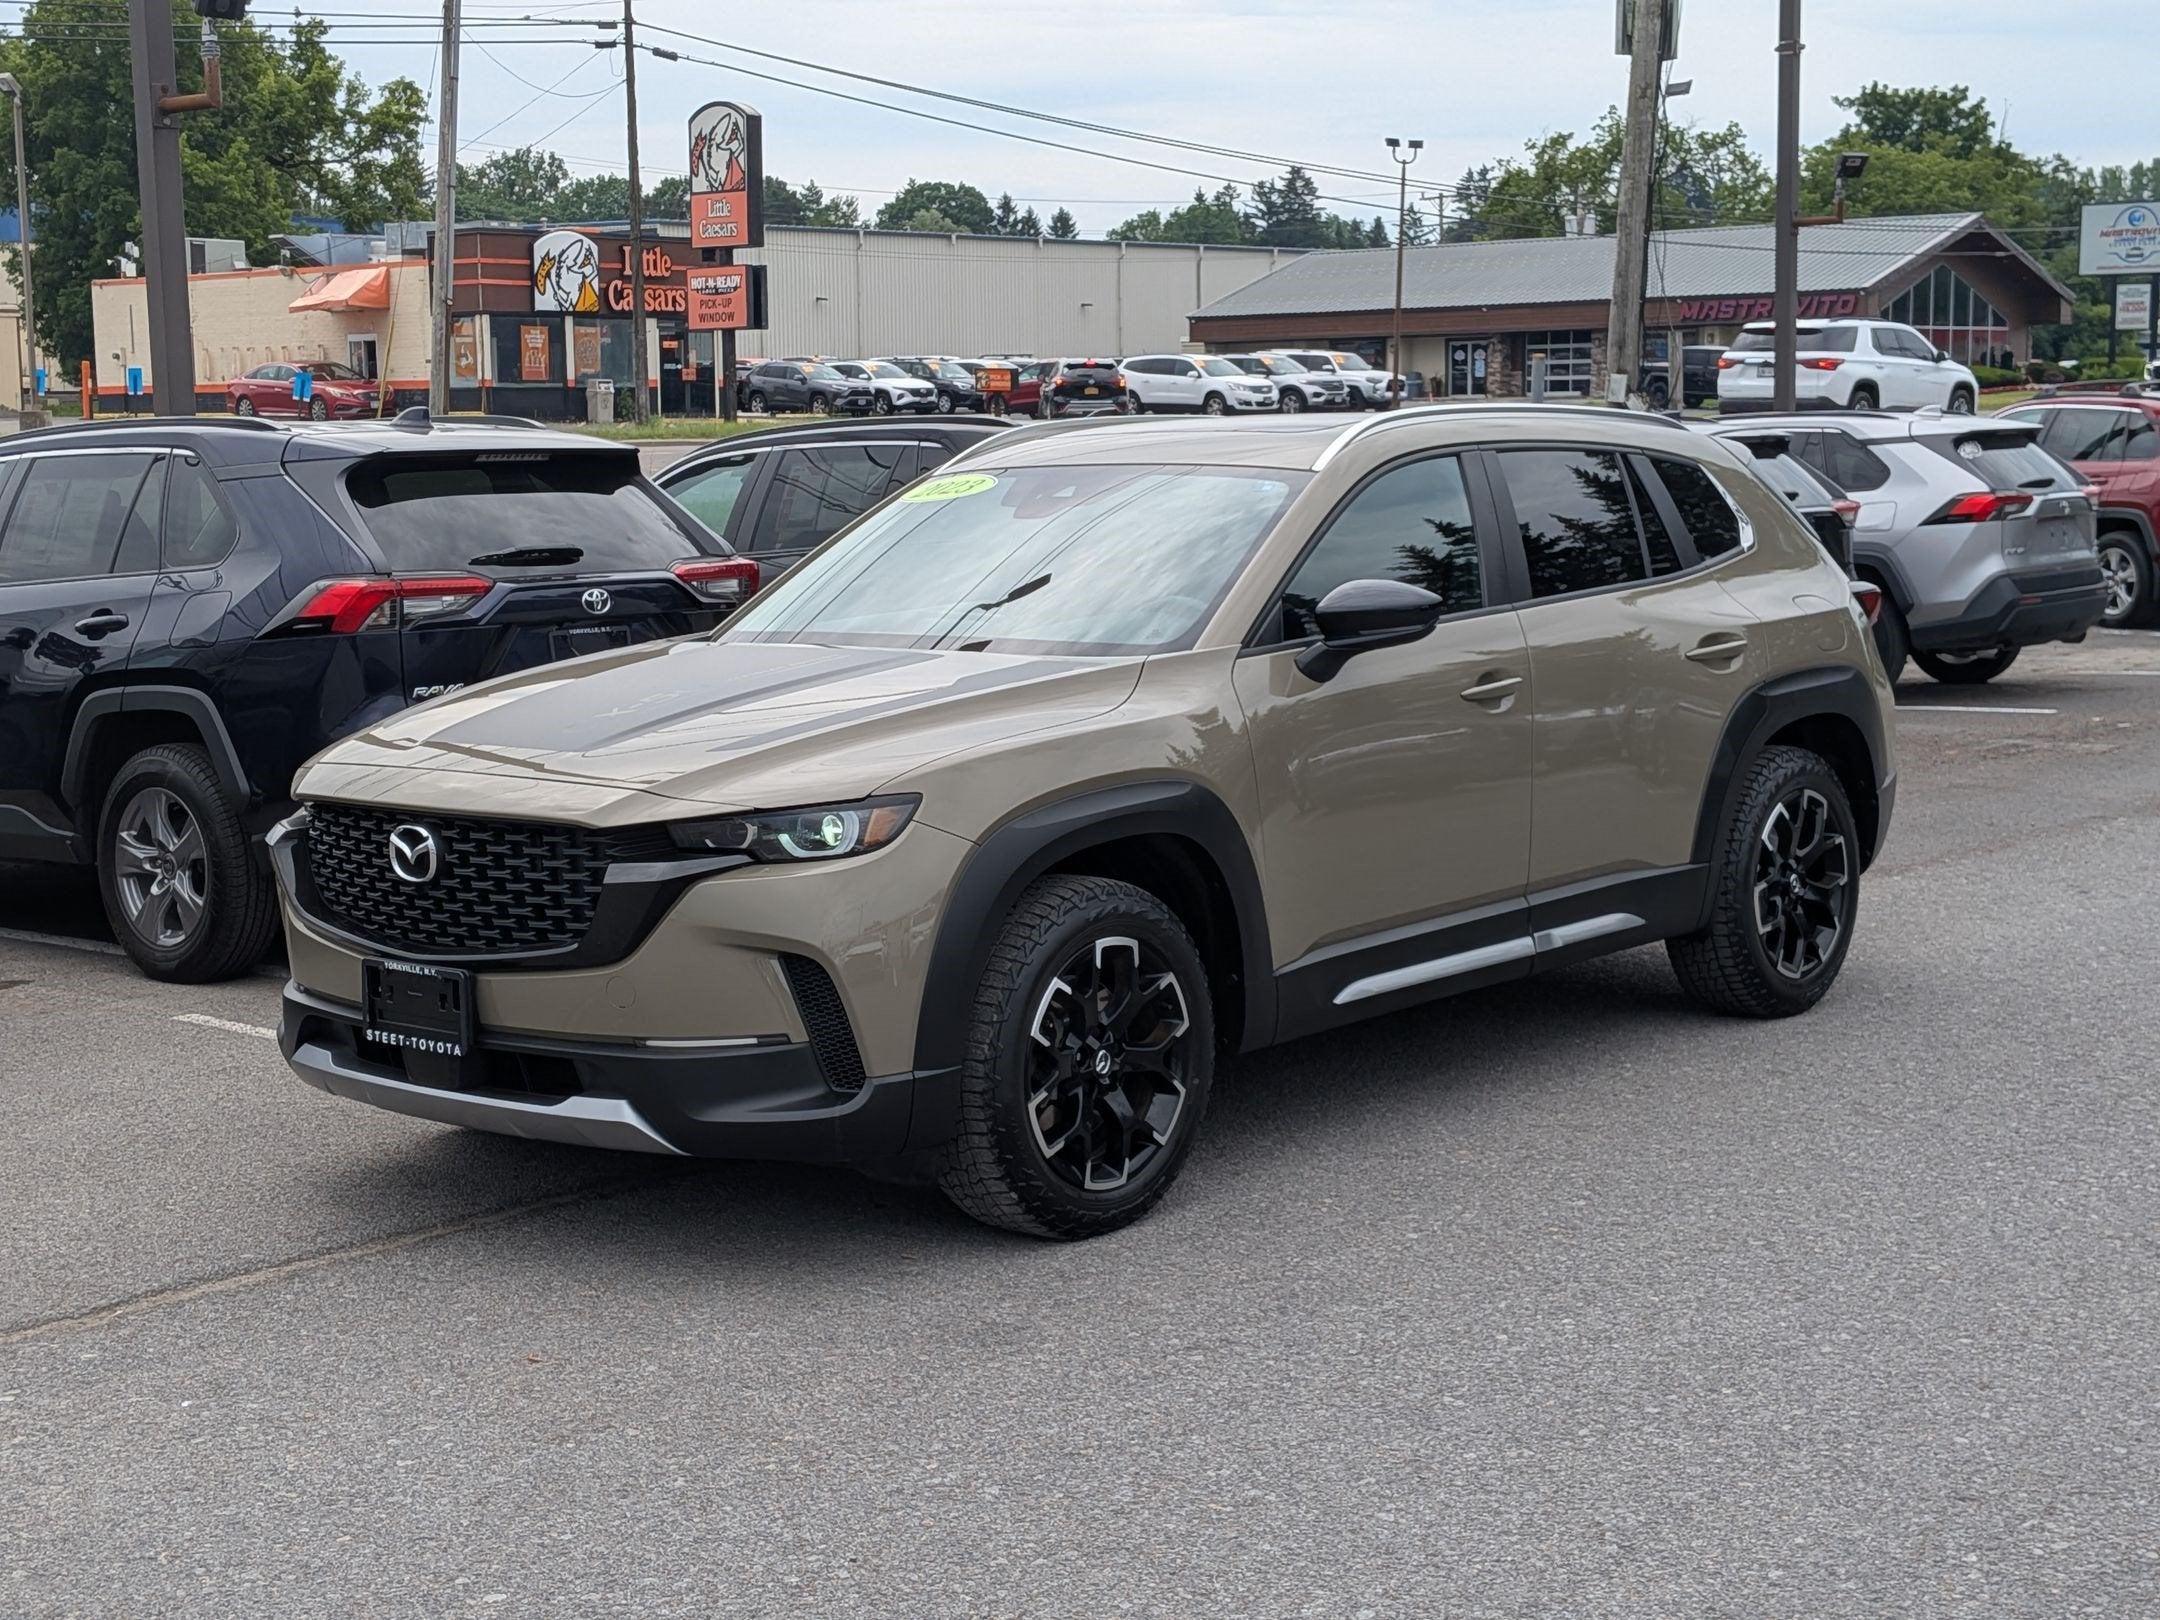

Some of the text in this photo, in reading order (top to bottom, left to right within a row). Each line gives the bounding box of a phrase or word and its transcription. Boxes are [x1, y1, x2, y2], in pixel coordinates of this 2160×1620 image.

[707, 199, 731, 217] Little
[700, 220, 737, 238] Caesars
[622, 245, 672, 277] Lttle
[691, 275, 741, 290] HOT-N-READY
[608, 280, 686, 311] Casars
[700, 298, 732, 309] PICK-UP
[1679, 295, 1856, 320] MASTRVITO
[698, 312, 735, 323] WINDOW
[384, 961, 438, 976] YORKVILLE, N.Y.
